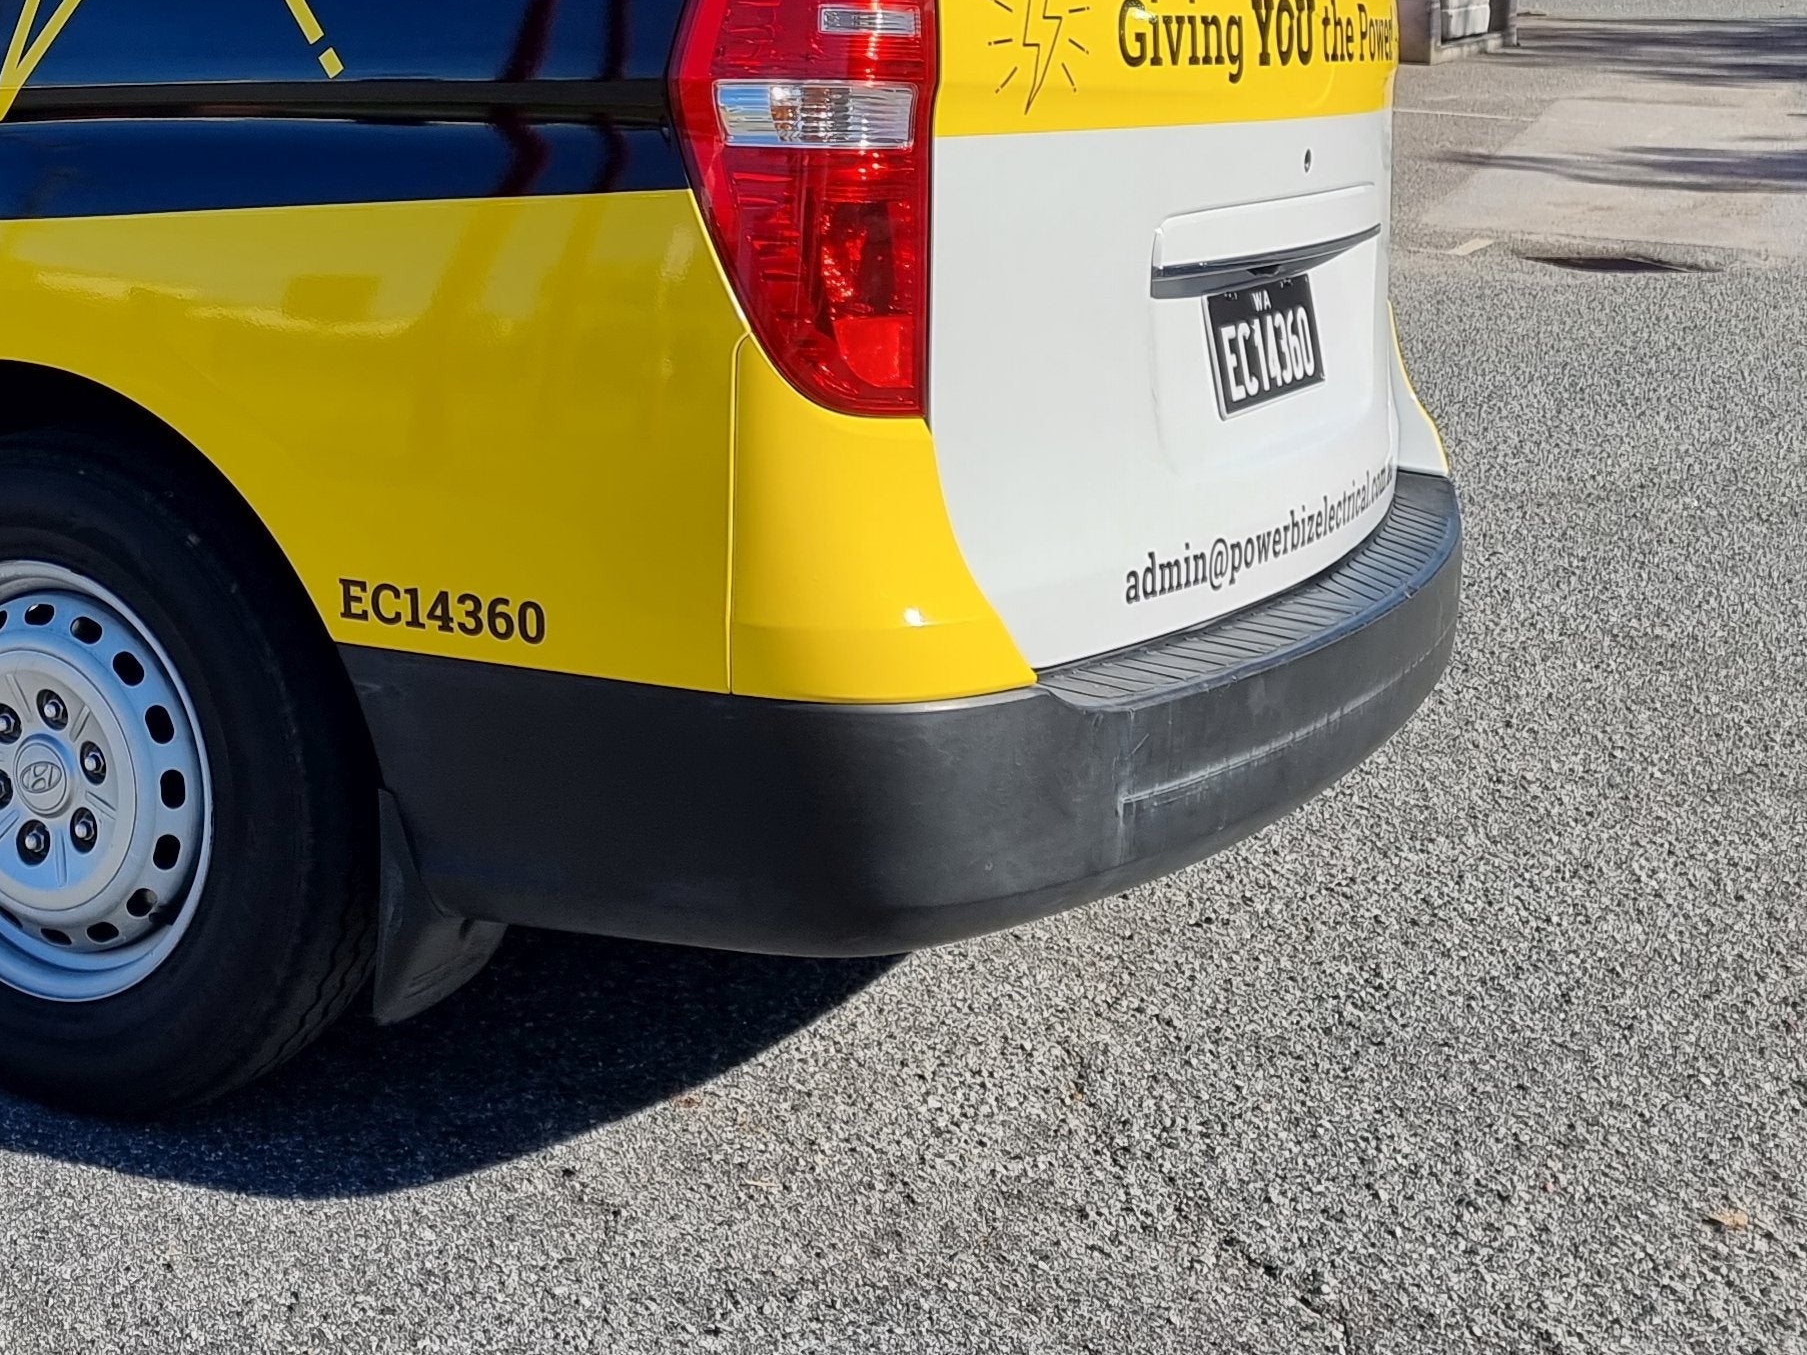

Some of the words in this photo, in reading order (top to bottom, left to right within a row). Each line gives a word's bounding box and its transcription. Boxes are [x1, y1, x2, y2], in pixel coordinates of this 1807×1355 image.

[1252, 289, 1271, 311] WA
[1221, 306, 1315, 402] EC14360
[339, 577, 545, 645] EC14360
